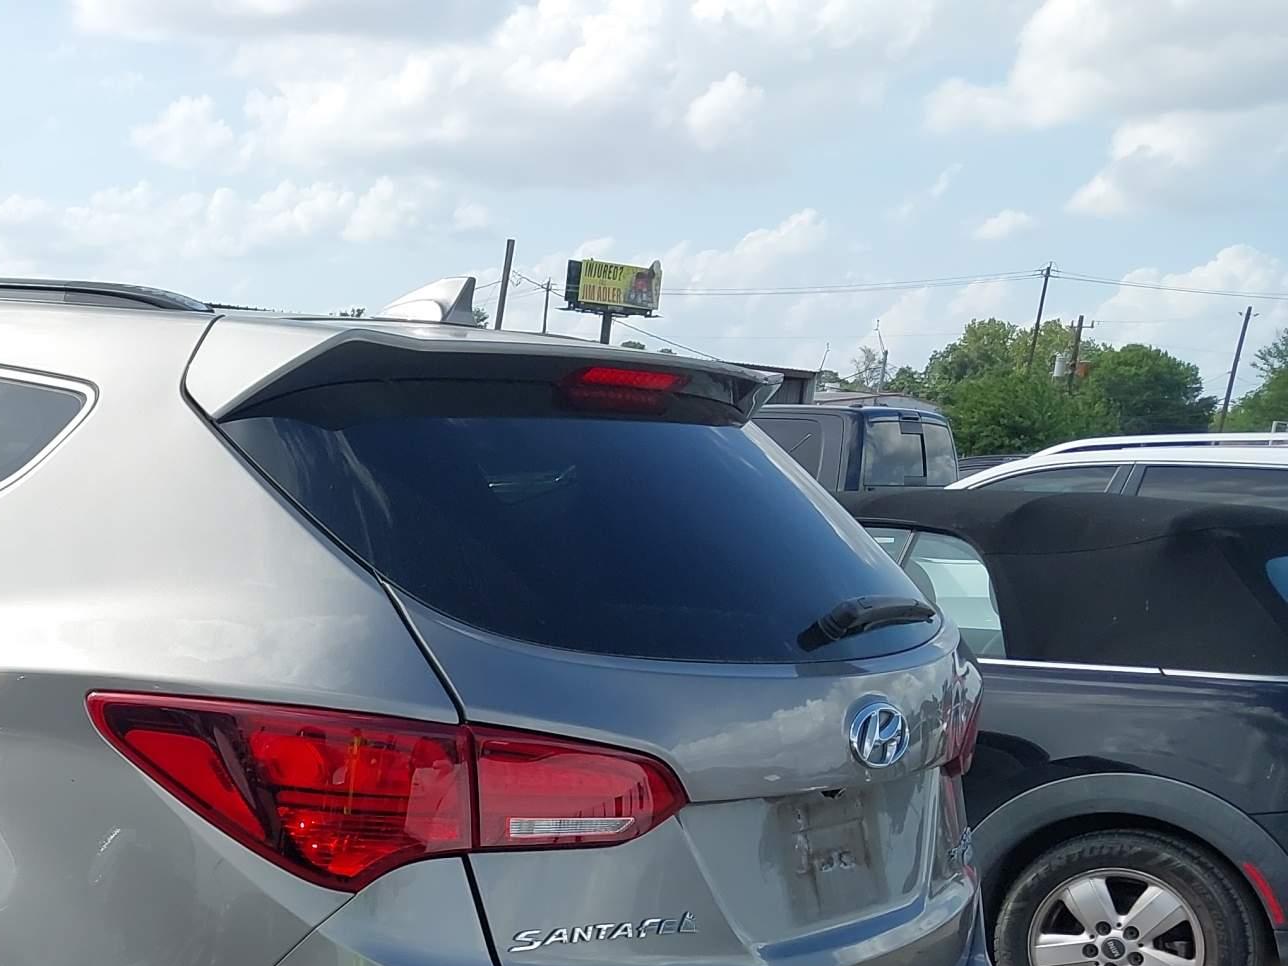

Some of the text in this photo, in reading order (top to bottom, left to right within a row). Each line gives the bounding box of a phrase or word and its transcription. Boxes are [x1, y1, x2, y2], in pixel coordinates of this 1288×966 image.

[584, 262, 624, 281] INJURED?
[582, 283, 622, 304] JIM ADLER
